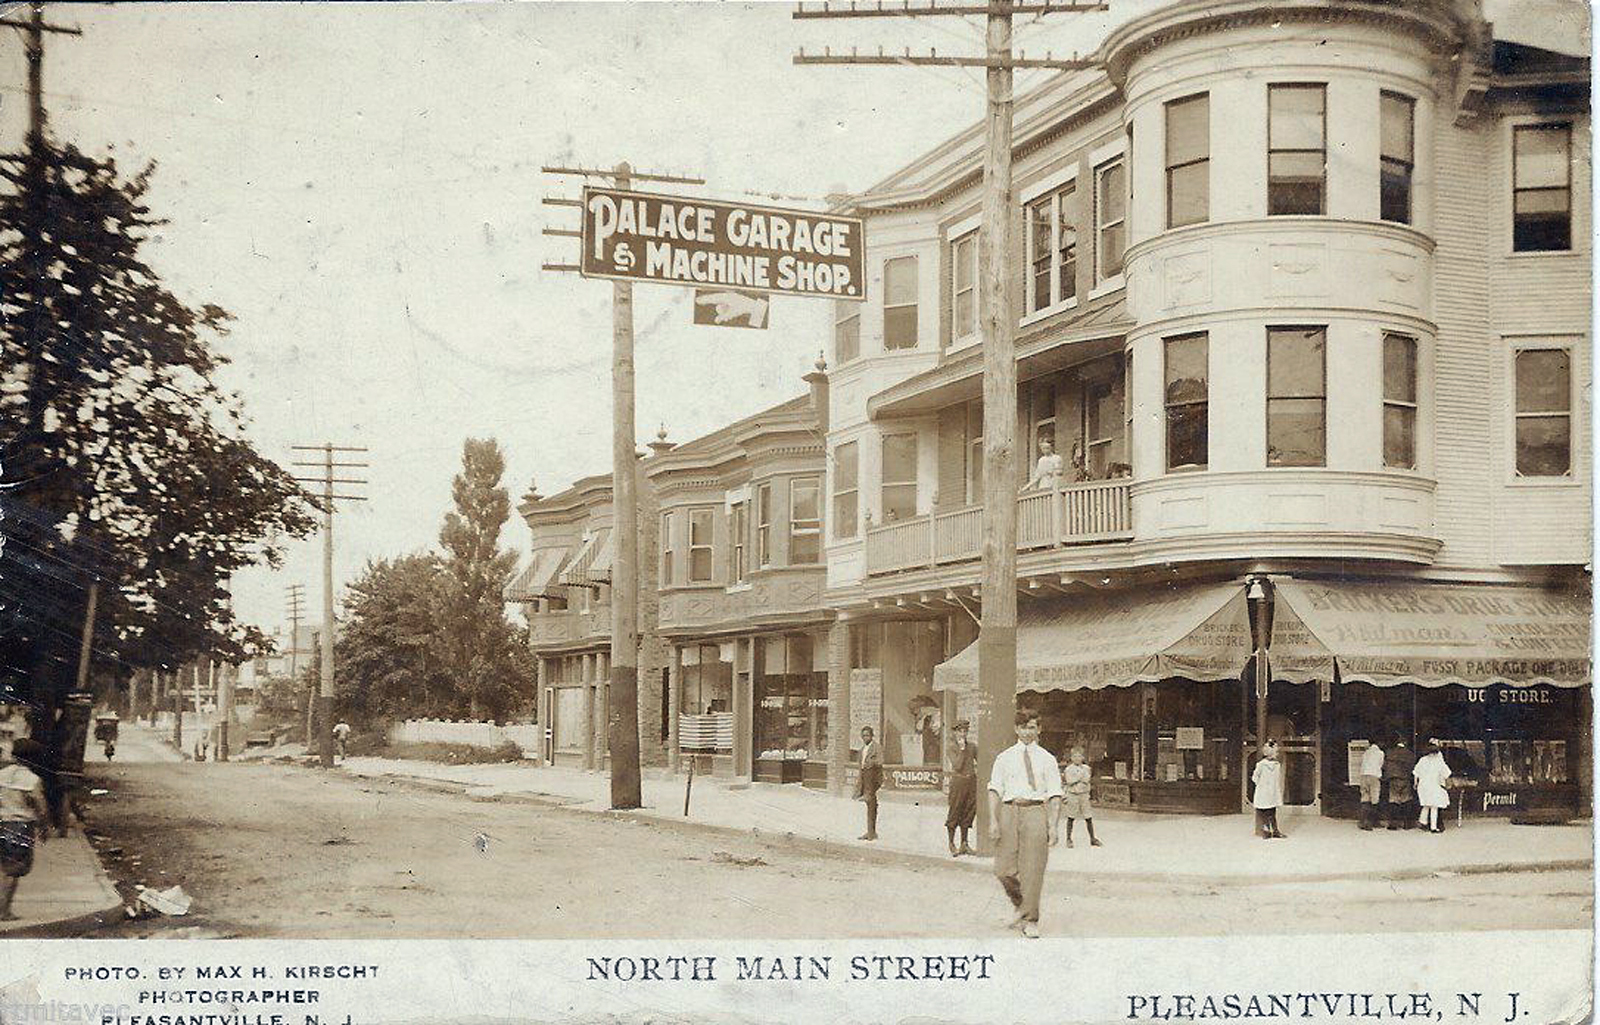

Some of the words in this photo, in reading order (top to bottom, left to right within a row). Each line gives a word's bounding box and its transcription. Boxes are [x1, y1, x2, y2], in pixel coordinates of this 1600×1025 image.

[588, 195, 716, 261] PALACE
[726, 209, 851, 257] GARAGE
[646, 241, 770, 288] MACHINE
[777, 255, 856, 296] SHOP.
[1444, 595, 1514, 616] DRUG
[1215, 634, 1246, 647] STORE
[1423, 660, 1459, 675] FUSSY
[1466, 661, 1528, 675] PACKAGE
[1531, 661, 1556, 675] ONE
